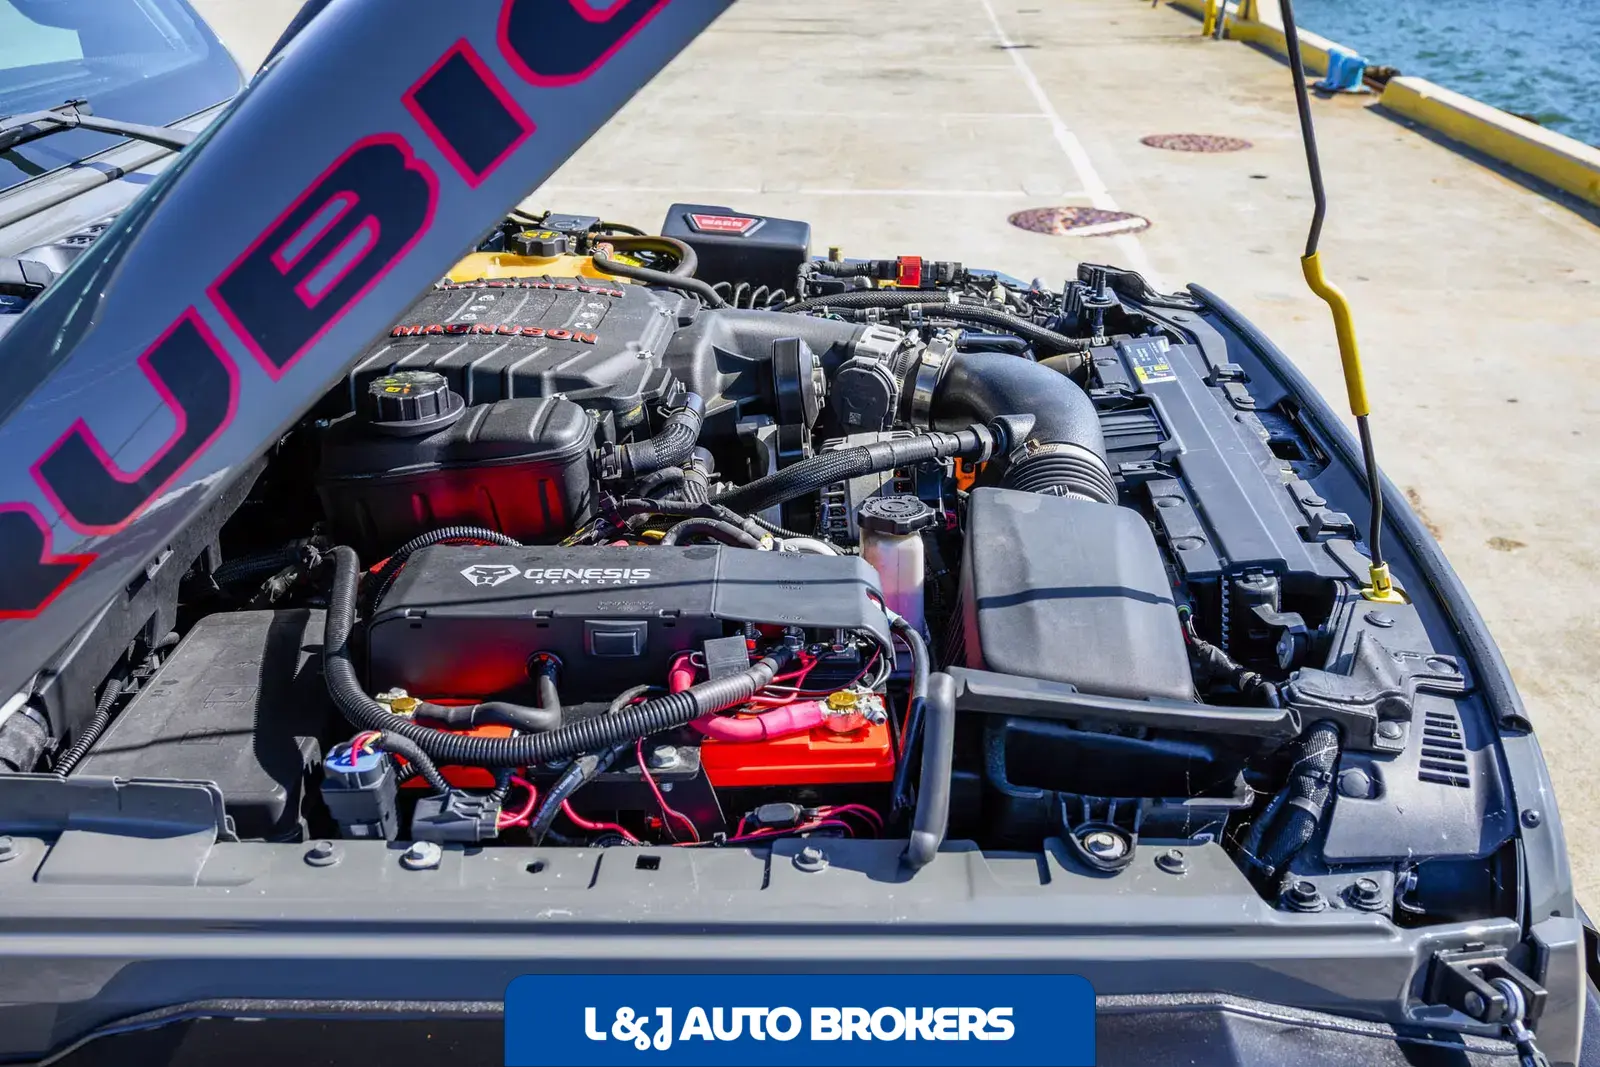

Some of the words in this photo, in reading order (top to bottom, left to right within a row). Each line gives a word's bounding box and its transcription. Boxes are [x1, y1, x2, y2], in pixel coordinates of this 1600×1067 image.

[701, 218, 743, 228] WARN
[389, 322, 599, 344] MAGNUSON
[523, 568, 652, 580] GENESIS
